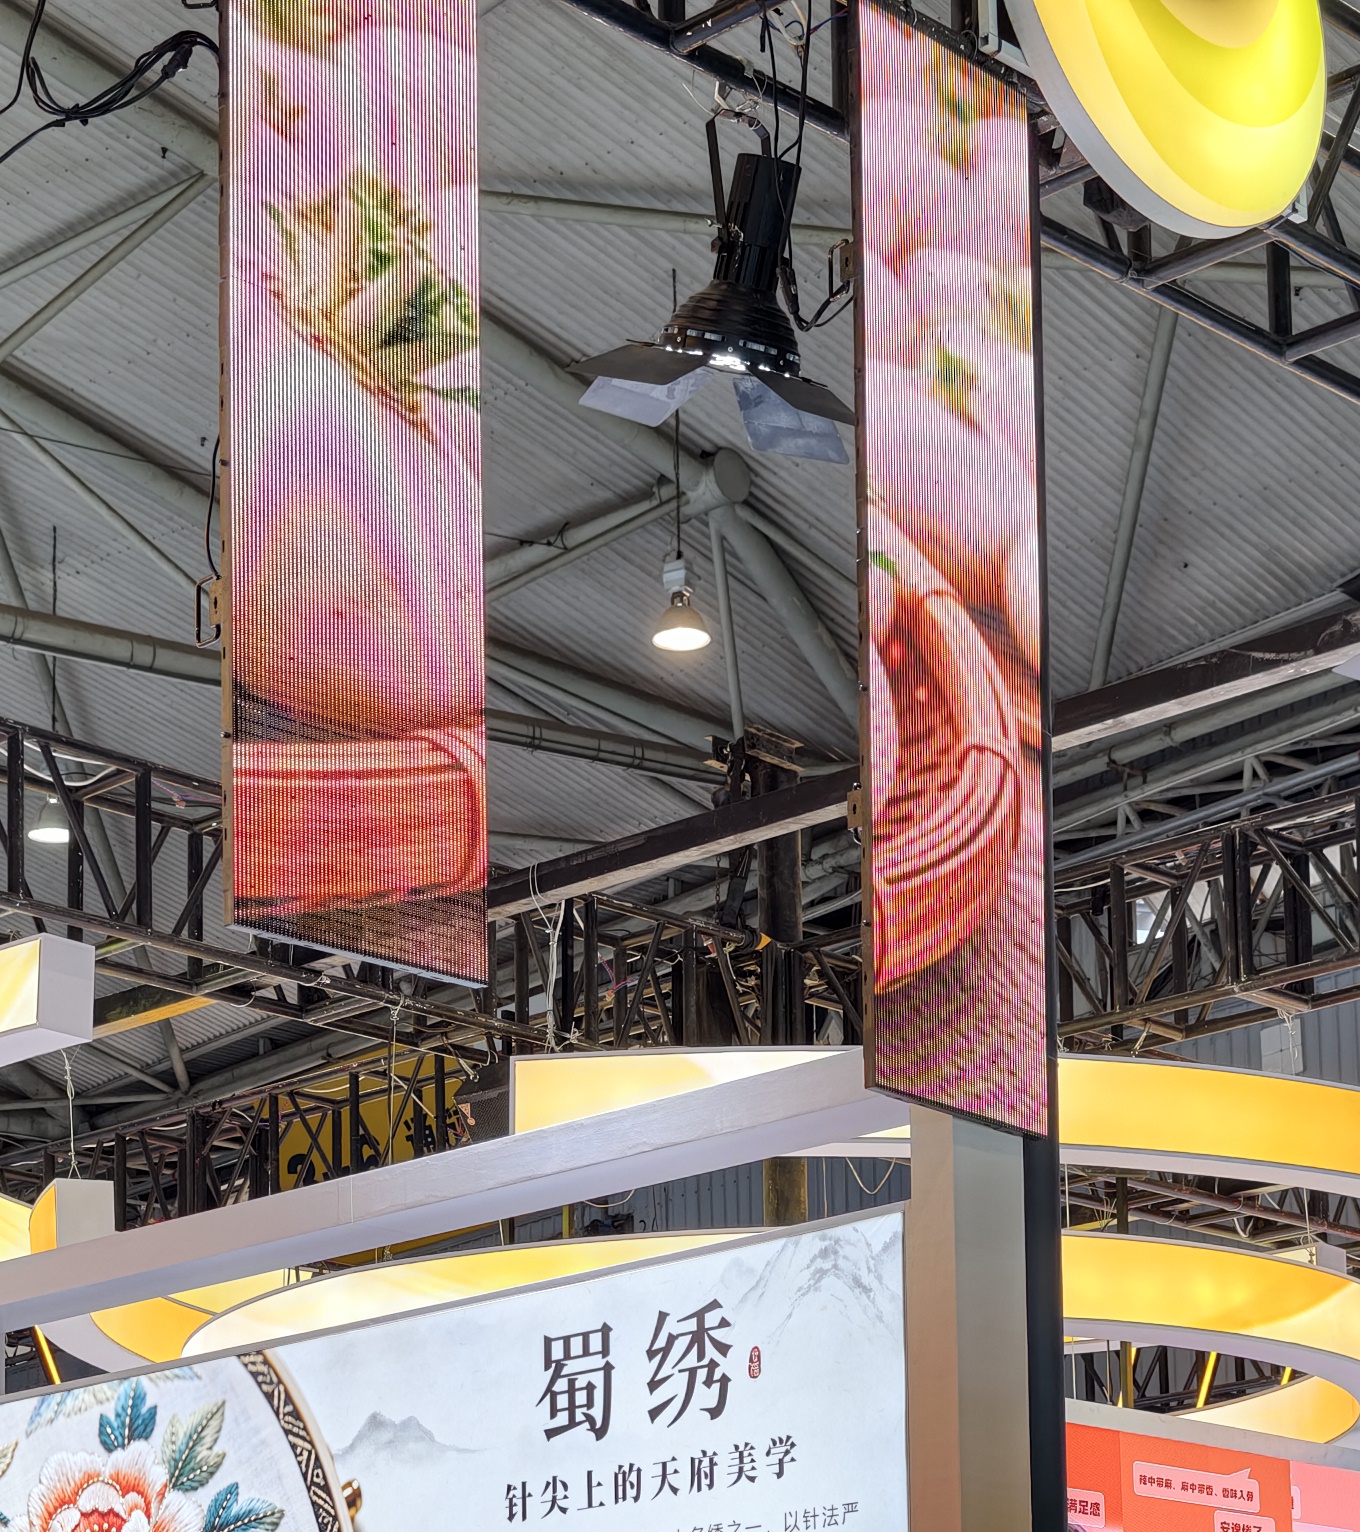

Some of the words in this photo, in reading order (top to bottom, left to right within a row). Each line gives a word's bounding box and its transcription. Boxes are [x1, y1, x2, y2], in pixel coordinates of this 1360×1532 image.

[536, 1298, 733, 1443] 蜀绣
[505, 1434, 797, 1523] 针尖上的天府美学
